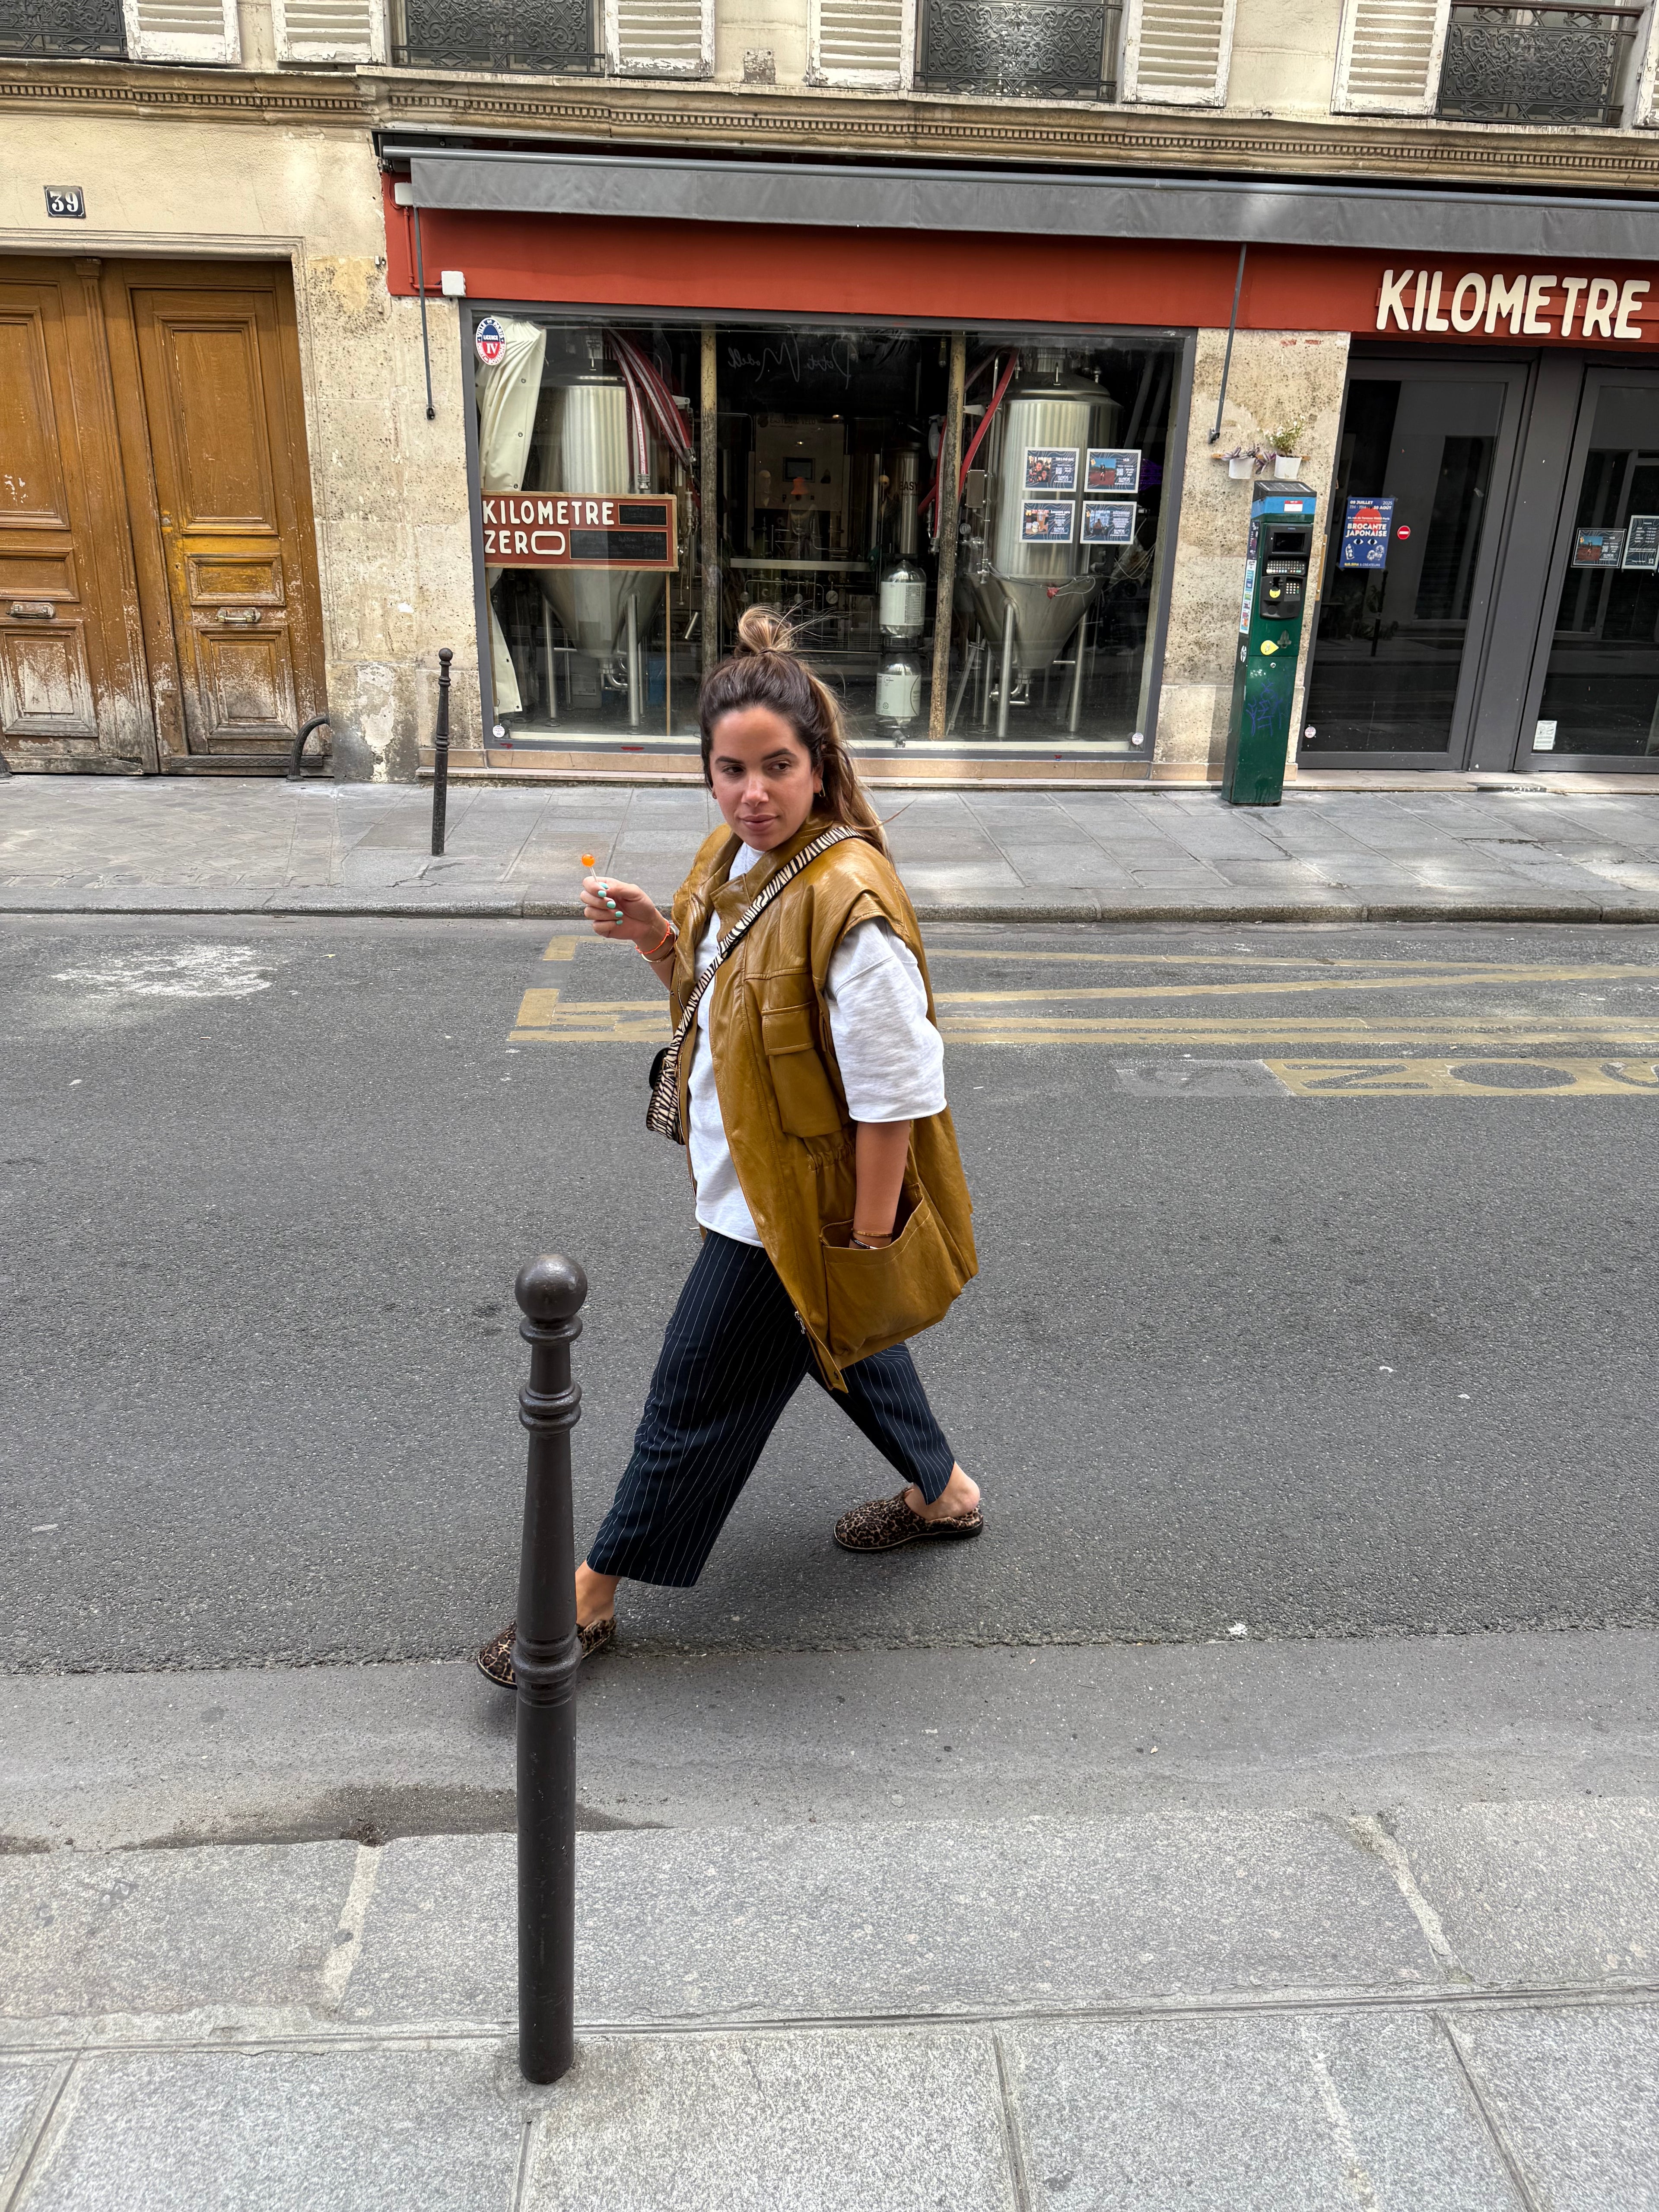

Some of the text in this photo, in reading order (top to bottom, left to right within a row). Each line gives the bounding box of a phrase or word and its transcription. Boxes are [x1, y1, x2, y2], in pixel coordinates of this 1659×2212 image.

[49, 191, 79, 212] 39
[1376, 269, 1650, 339] KILOMETRE
[477, 321, 487, 337] VILLE
[493, 321, 504, 338] PARIS
[486, 343, 498, 354] IV
[483, 500, 615, 525] KILOMETRE
[484, 530, 566, 555] ZERO
